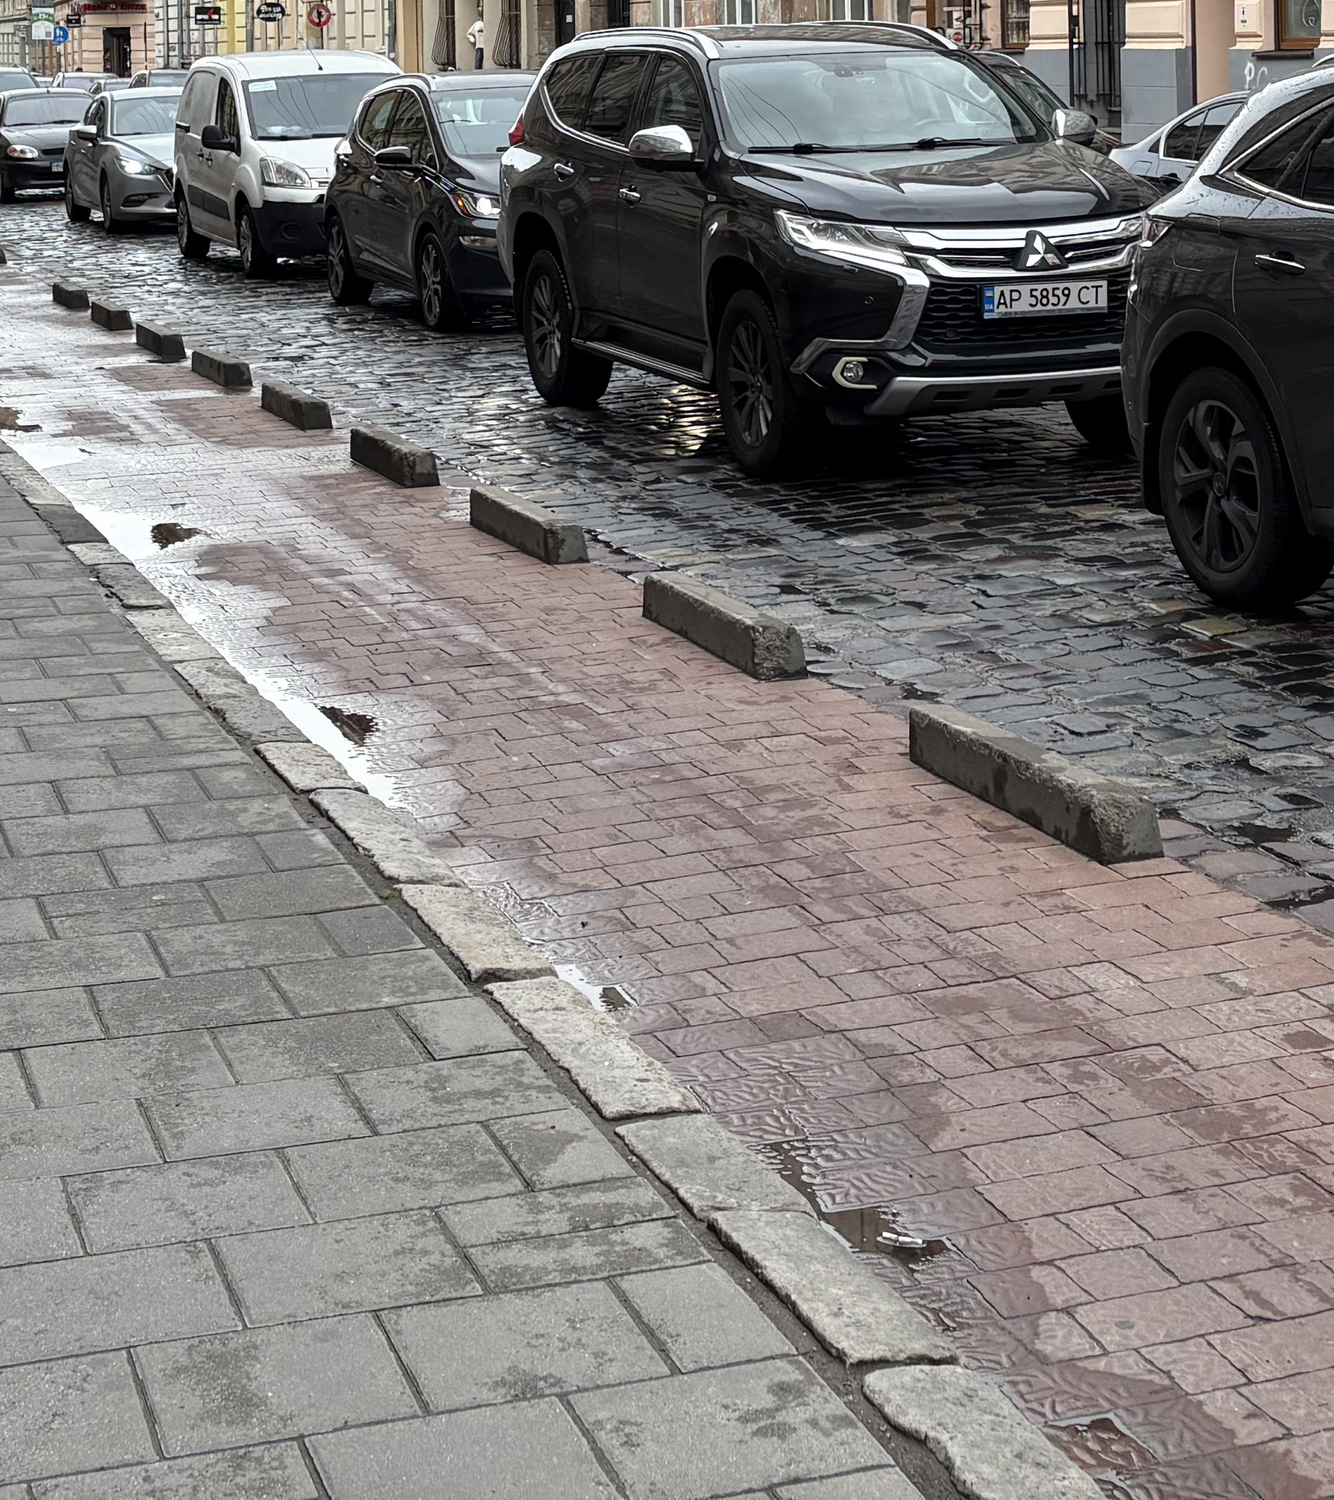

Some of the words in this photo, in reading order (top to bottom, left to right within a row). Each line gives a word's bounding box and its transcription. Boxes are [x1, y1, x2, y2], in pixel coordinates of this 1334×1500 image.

[996, 289, 1022, 310] AP
[1028, 287, 1071, 308] 5859
[1077, 285, 1103, 306] CT
